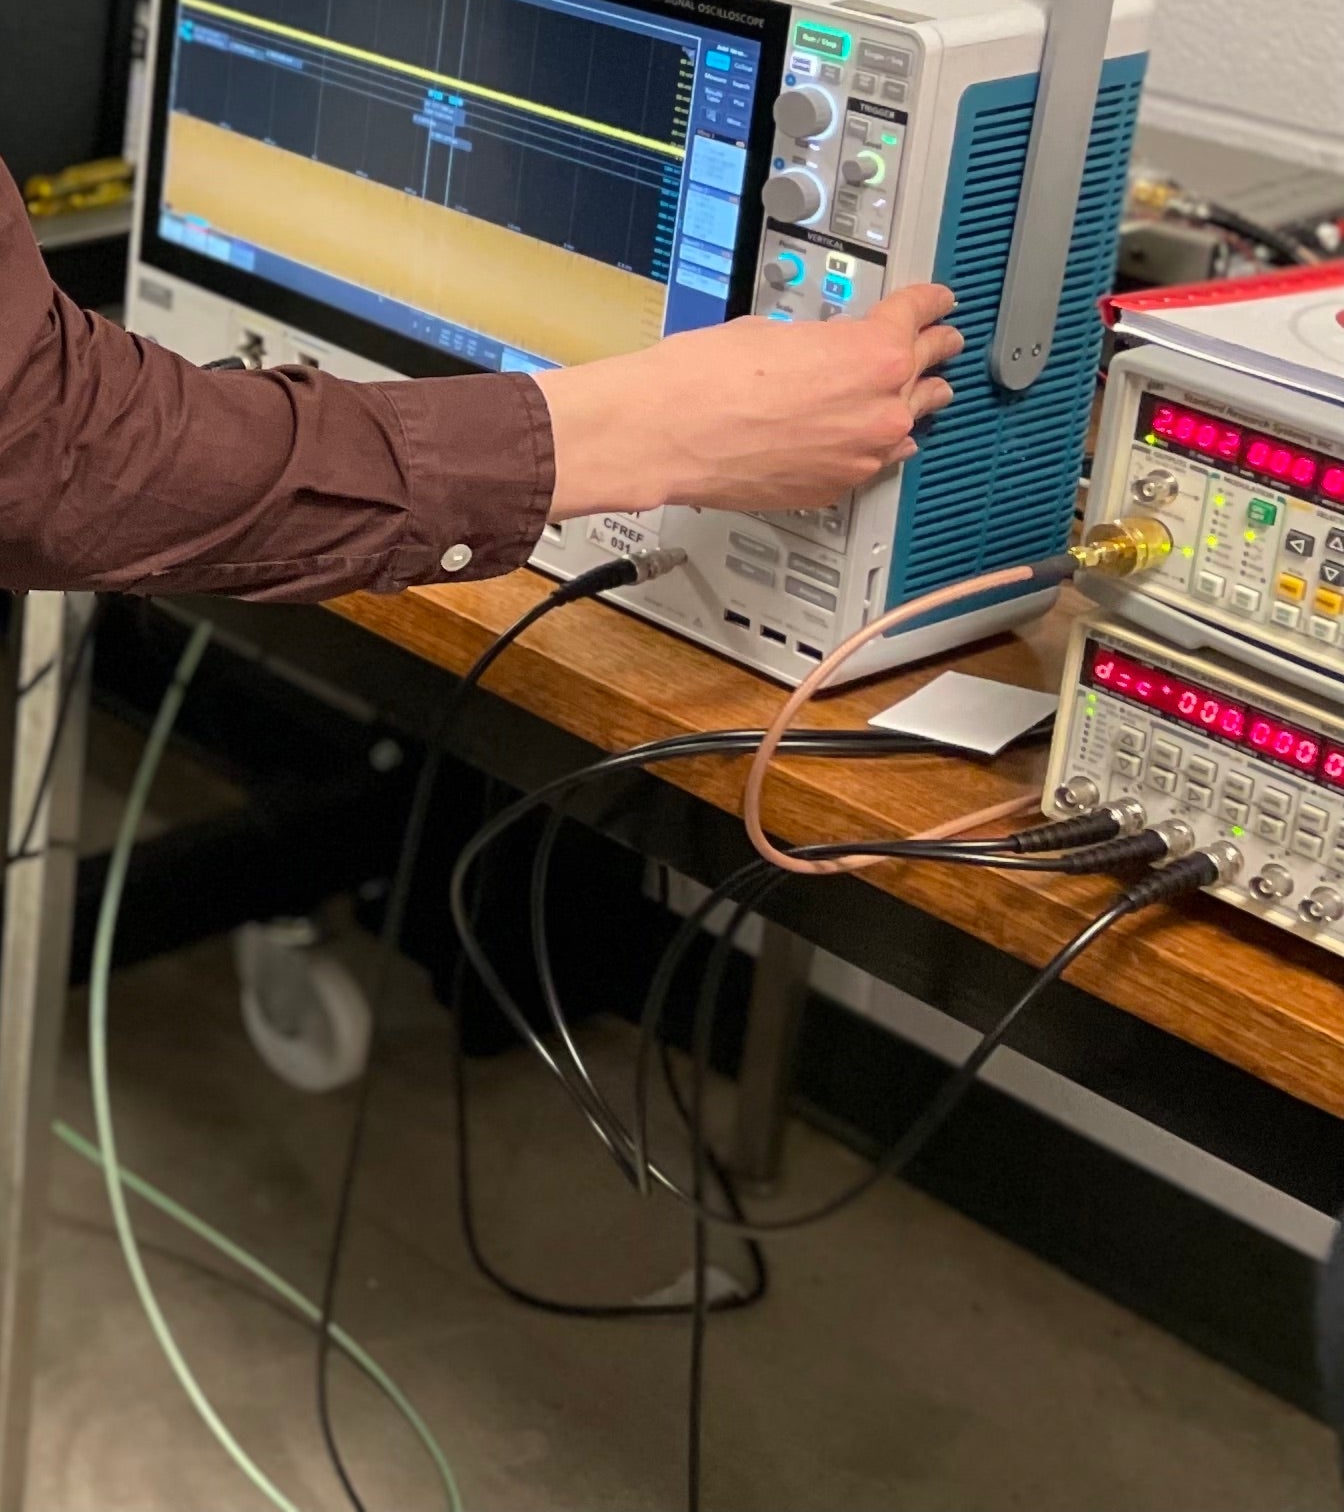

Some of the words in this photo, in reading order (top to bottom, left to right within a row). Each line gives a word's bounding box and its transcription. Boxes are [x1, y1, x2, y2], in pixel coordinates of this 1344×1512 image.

[697, 3, 766, 29] OSCILLOSCOPE
[821, 36, 838, 50] Stop
[860, 103, 896, 120] TRIGGER
[807, 231, 844, 251] VERTICAL
[603, 517, 645, 543] CFREF
[610, 536, 631, 554] 031
